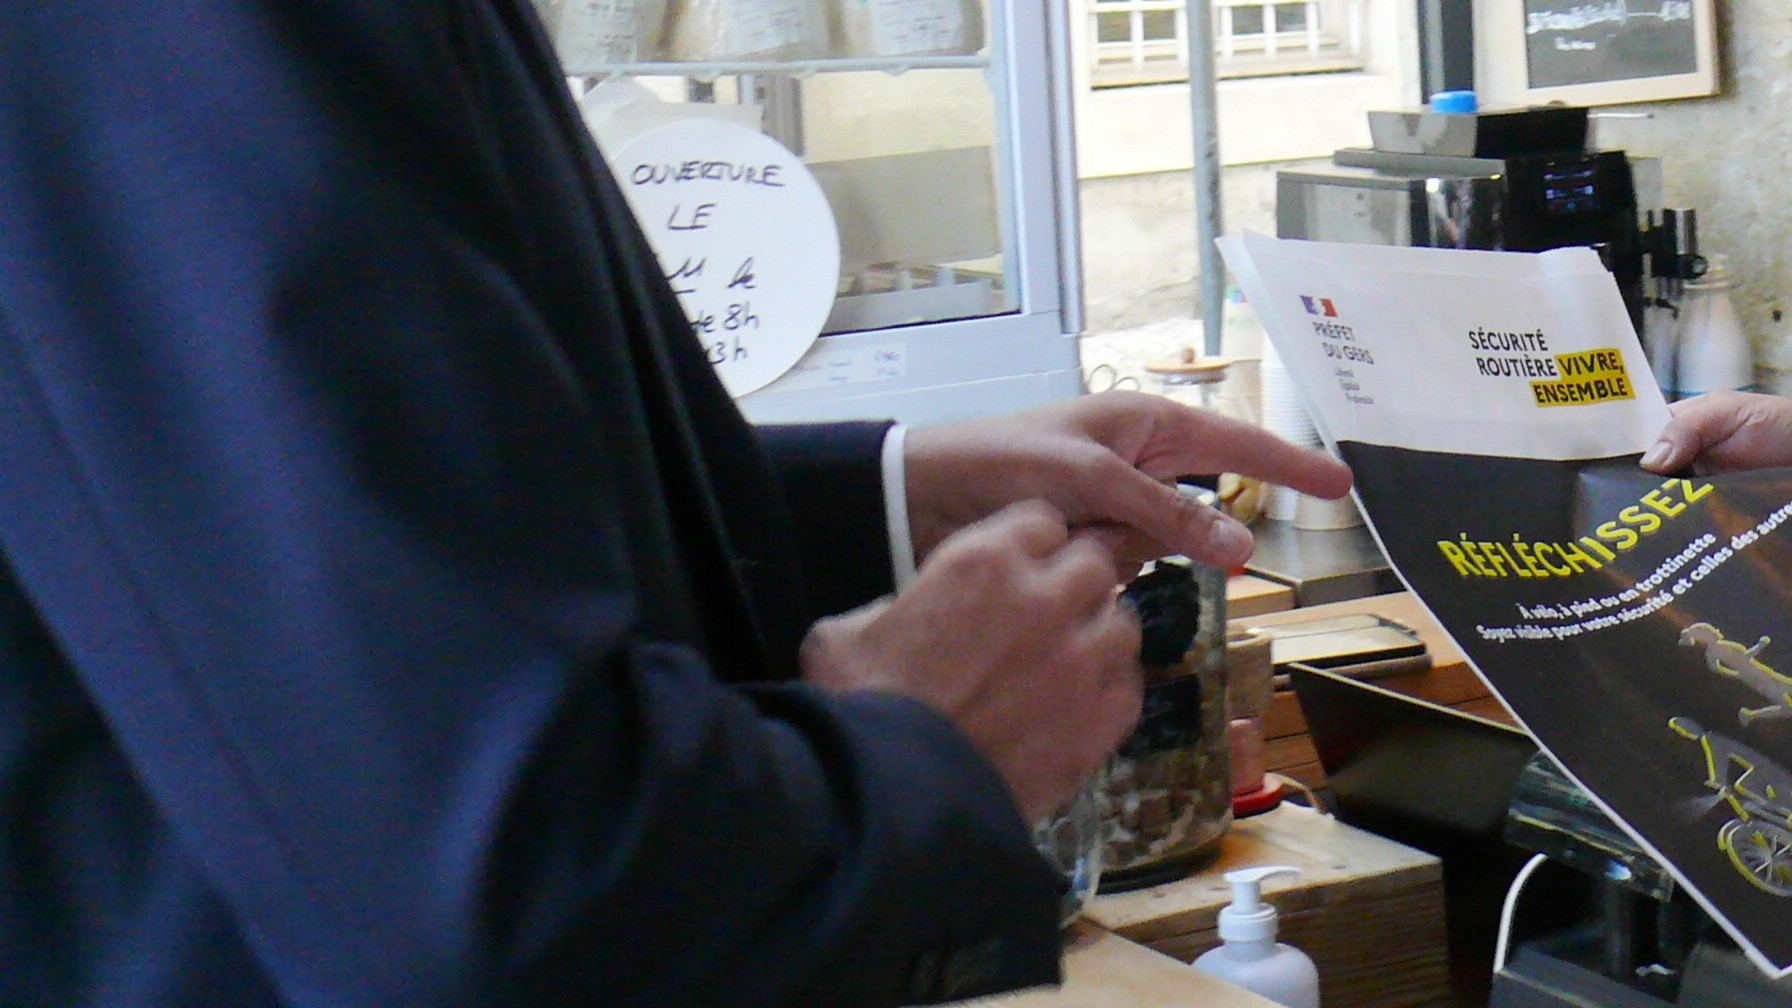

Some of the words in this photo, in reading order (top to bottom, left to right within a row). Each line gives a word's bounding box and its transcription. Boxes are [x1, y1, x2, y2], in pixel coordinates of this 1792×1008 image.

[632, 160, 786, 187] OUVERTURE
[667, 203, 717, 230] LE
[723, 300, 760, 331] 8h
[1312, 320, 1356, 342] PRÉFET
[1468, 327, 1549, 352] SÉCURITÉ
[1322, 342, 1342, 360] DU
[1342, 345, 1375, 365] GERS
[1475, 354, 1557, 378] ROUTIÈRE
[1558, 351, 1625, 376] VIVRE,
[1532, 377, 1628, 404] ENSEMBLE
[1437, 478, 1715, 577] RÉFLÉCHISSEZ
[1476, 624, 1517, 644] Soyez
[1514, 623, 1554, 640] visible
[1551, 623, 1584, 641] pour
[1581, 614, 1620, 632] votre
[1618, 589, 1675, 623] sécurité
[1672, 577, 1694, 595] et
[1690, 546, 1734, 582] celles
[1730, 529, 1760, 551] des
[1570, 598, 1602, 618] pied
[1600, 595, 1620, 608] ou
[1618, 588, 1640, 603] en
[1636, 533, 1717, 593] trottinette
